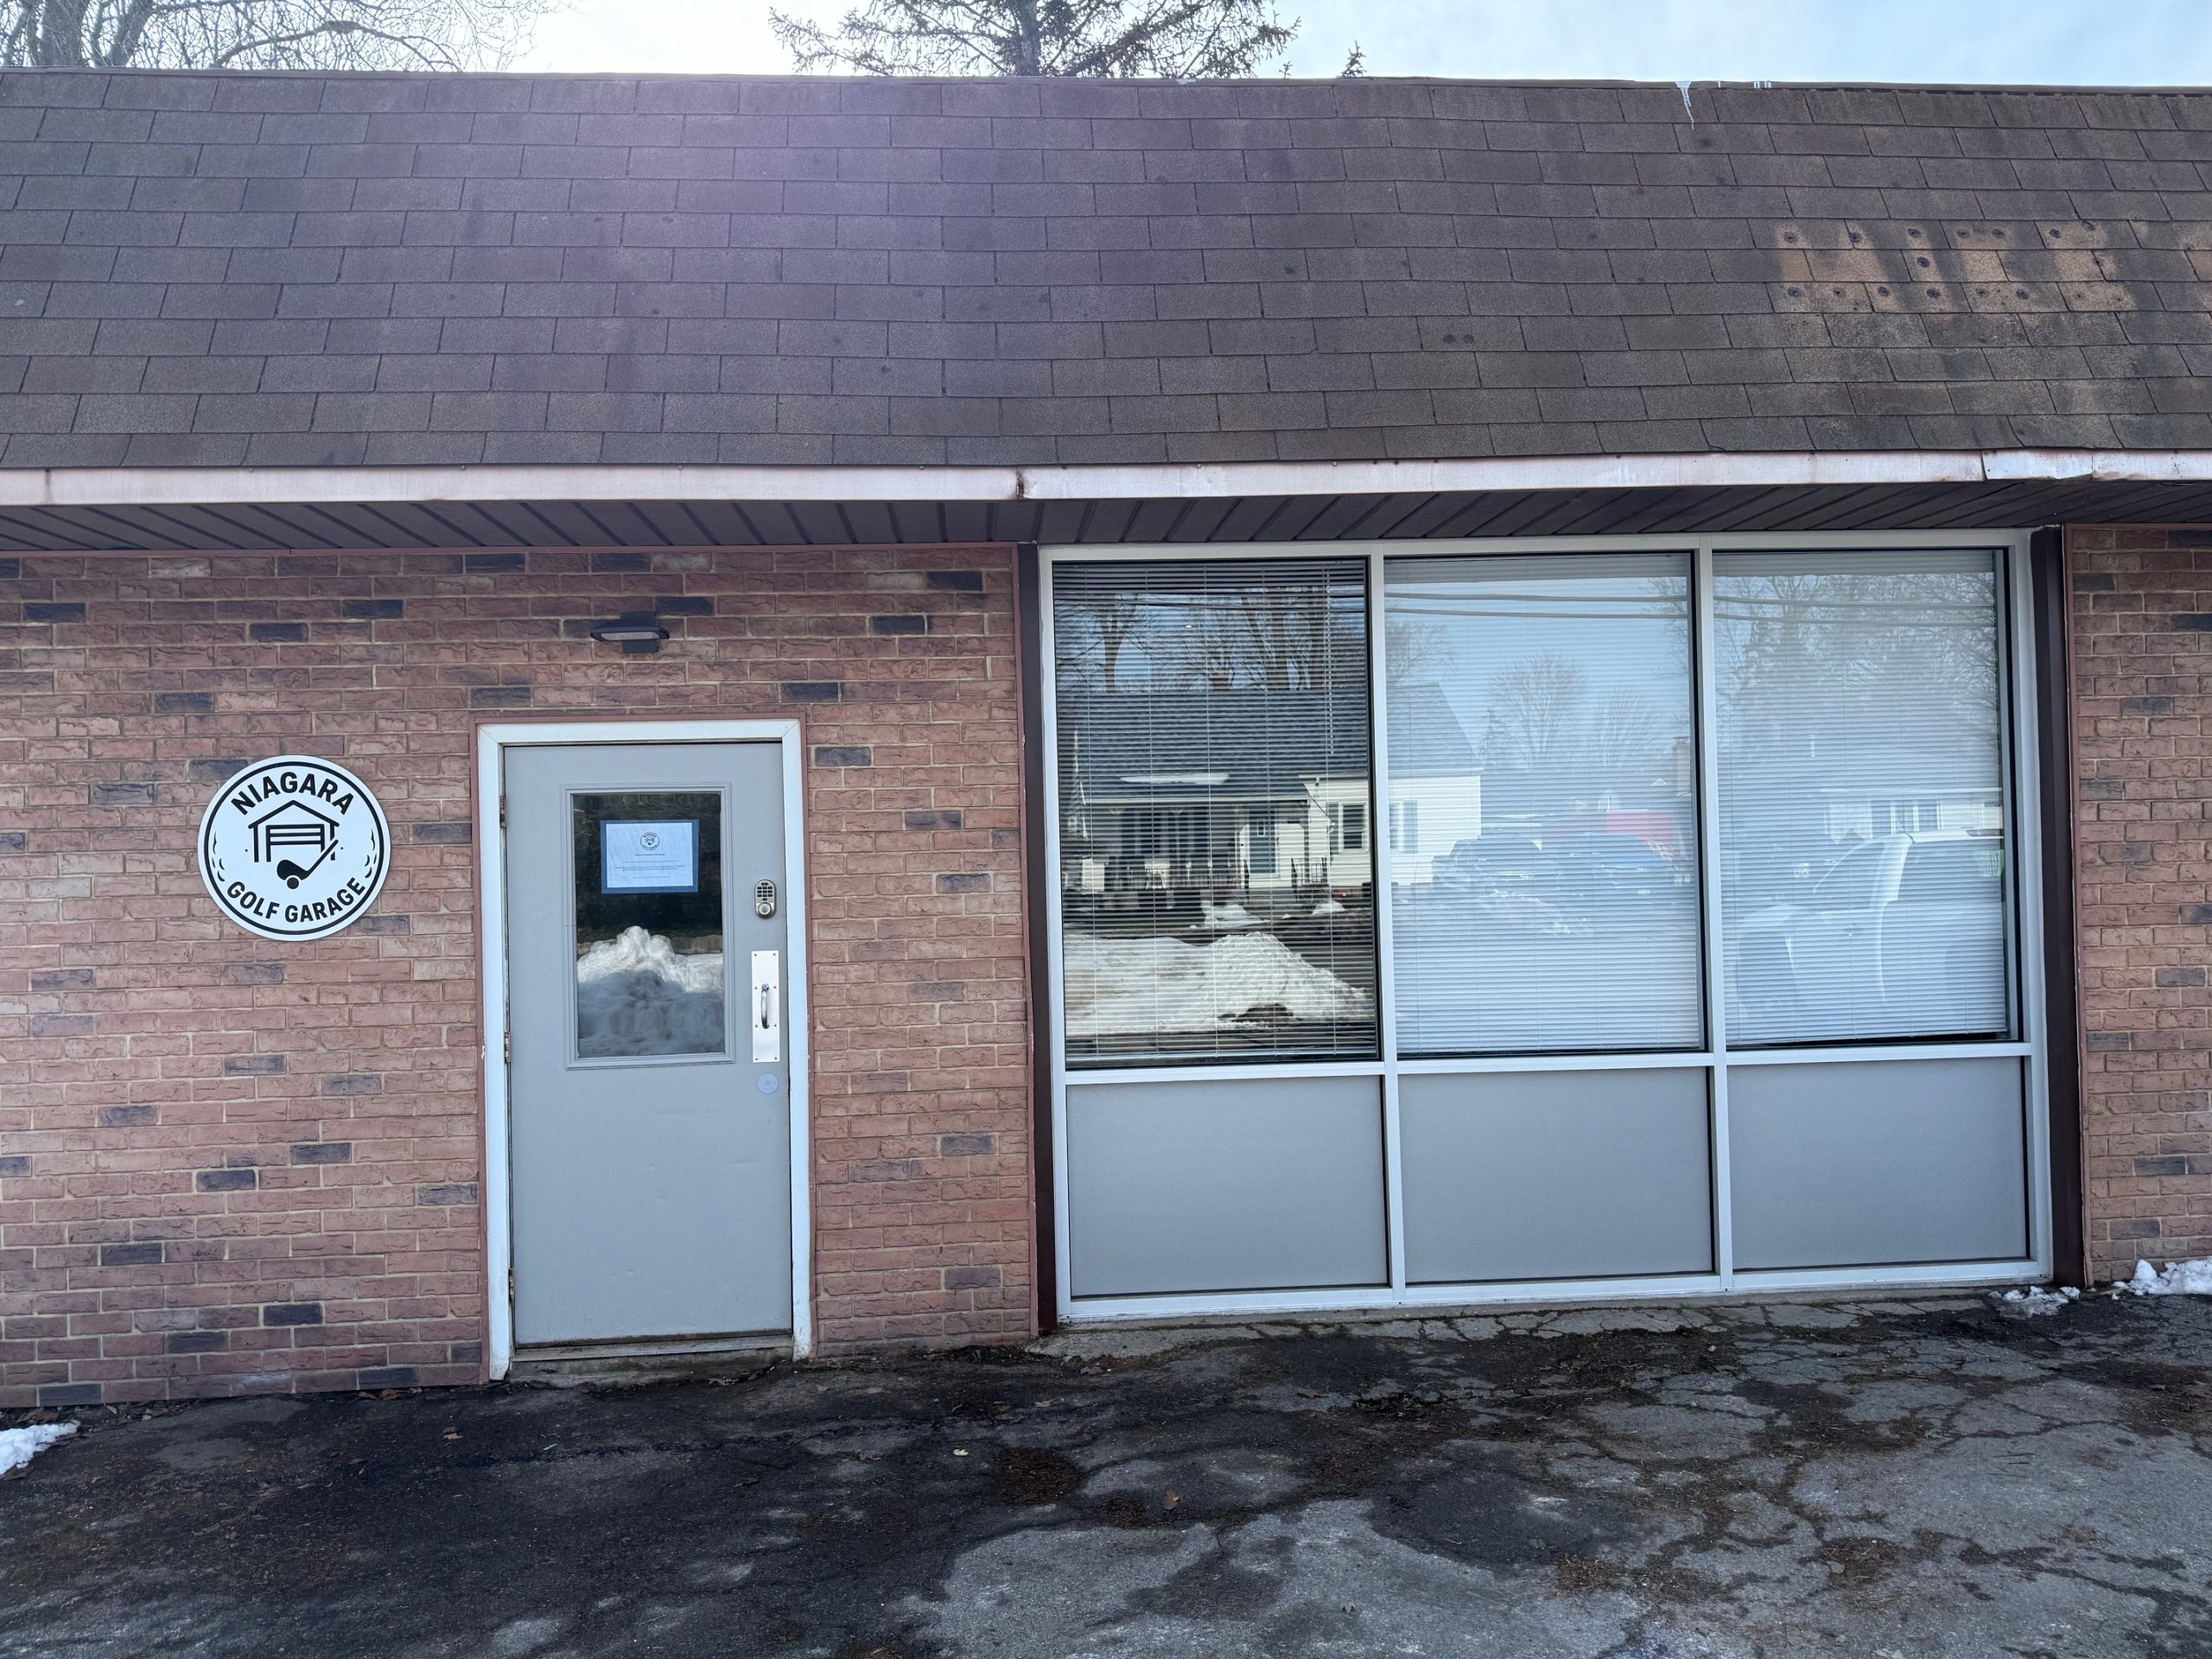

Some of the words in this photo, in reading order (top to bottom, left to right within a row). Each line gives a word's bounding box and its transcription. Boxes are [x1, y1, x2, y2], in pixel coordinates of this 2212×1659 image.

[231, 772, 354, 815] NIAGARA
[227, 881, 279, 919] GOLF
[284, 878, 365, 923] GARAGE
